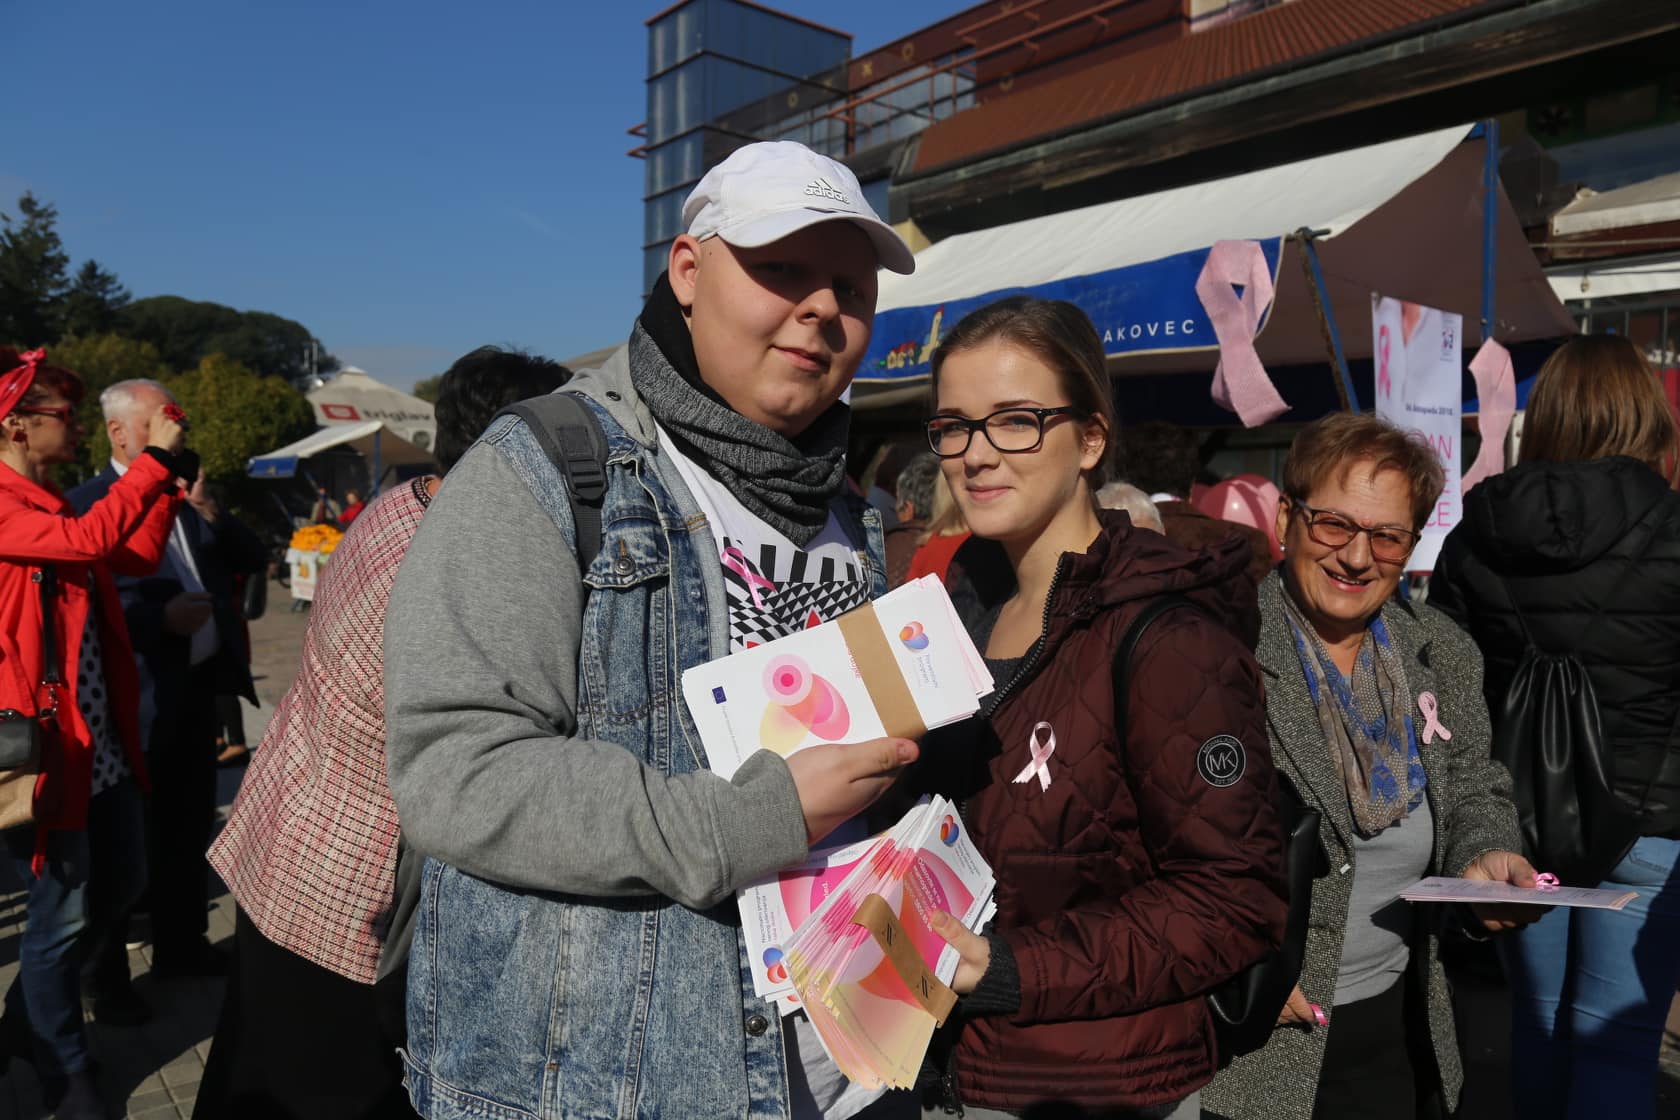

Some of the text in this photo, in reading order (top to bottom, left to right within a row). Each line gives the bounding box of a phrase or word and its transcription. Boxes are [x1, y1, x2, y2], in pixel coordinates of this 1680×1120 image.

[804, 186, 850, 205] adidas
[1104, 319, 1195, 343] AKOVEC
[1209, 750, 1237, 772] MK
